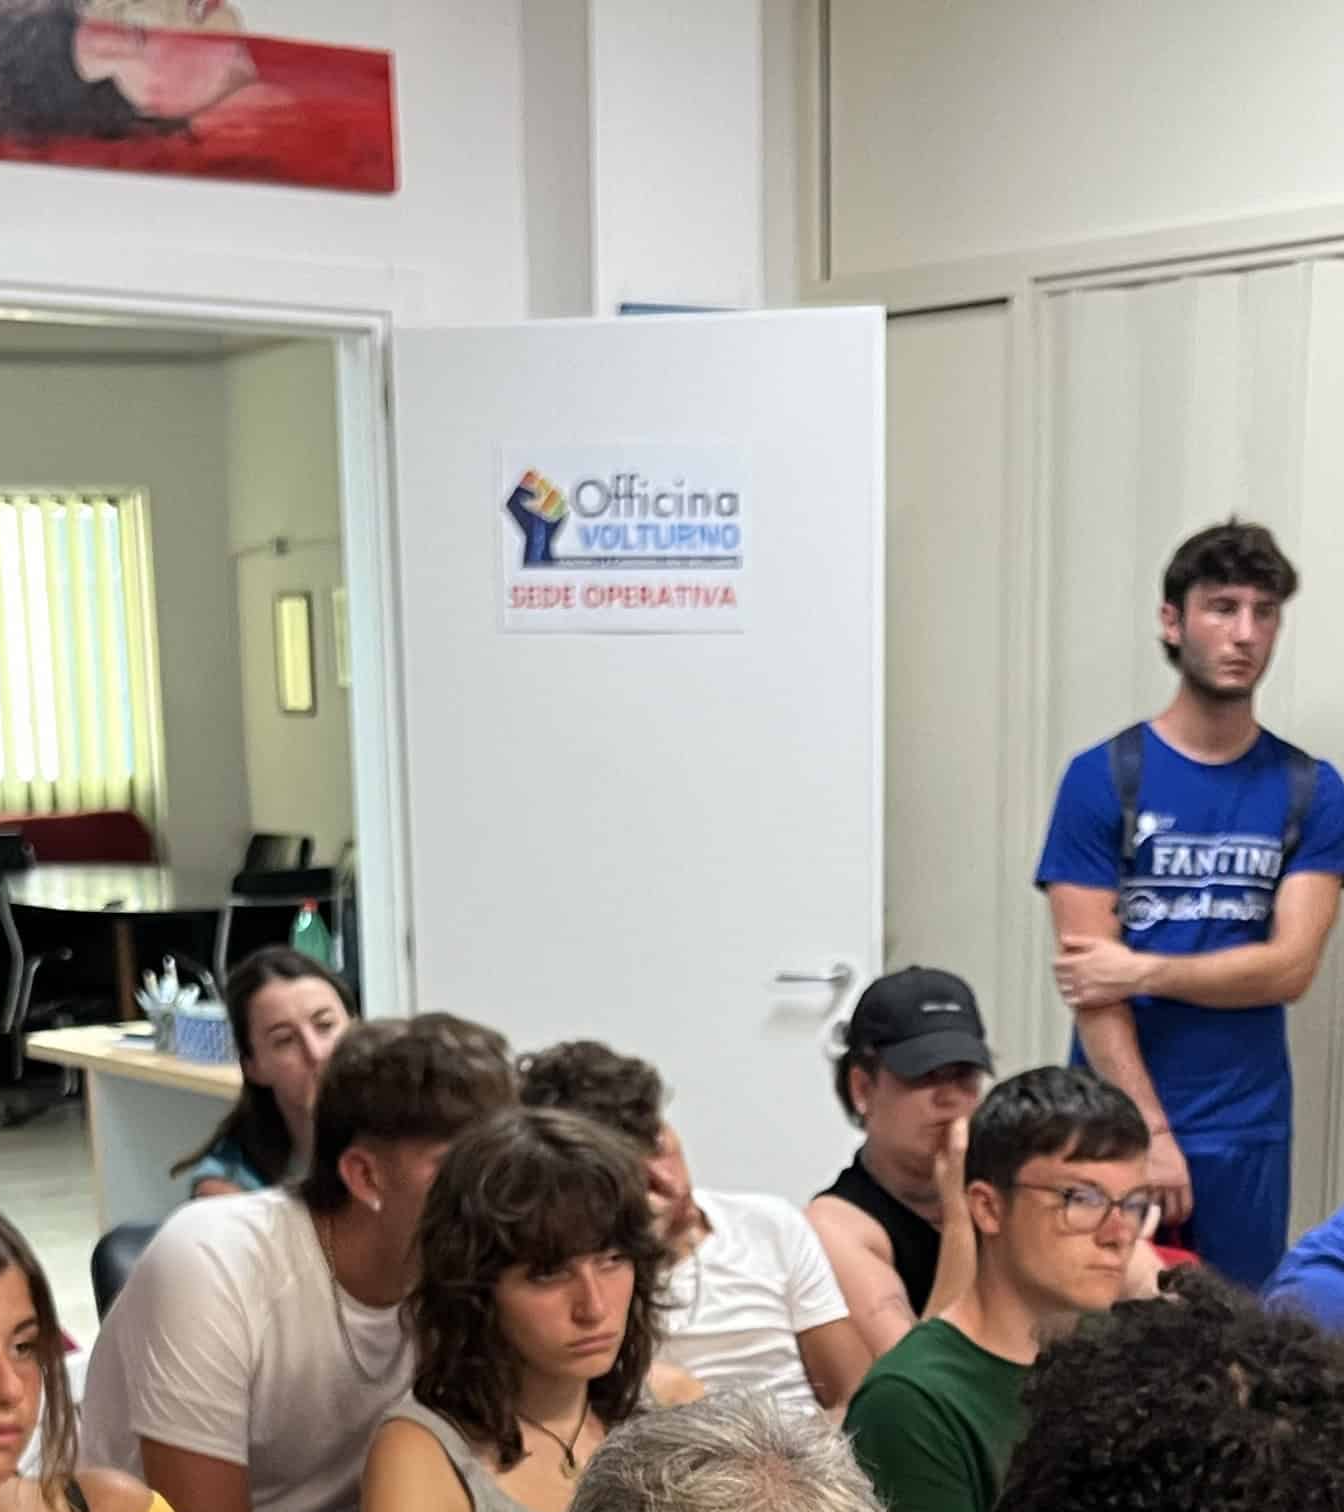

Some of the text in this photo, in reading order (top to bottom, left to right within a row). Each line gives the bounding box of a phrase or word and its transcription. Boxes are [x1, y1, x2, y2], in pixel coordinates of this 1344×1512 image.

[574, 472, 740, 518] Officina
[581, 523, 741, 550] VOLTURNO
[582, 585, 738, 609] OPERATIVA
